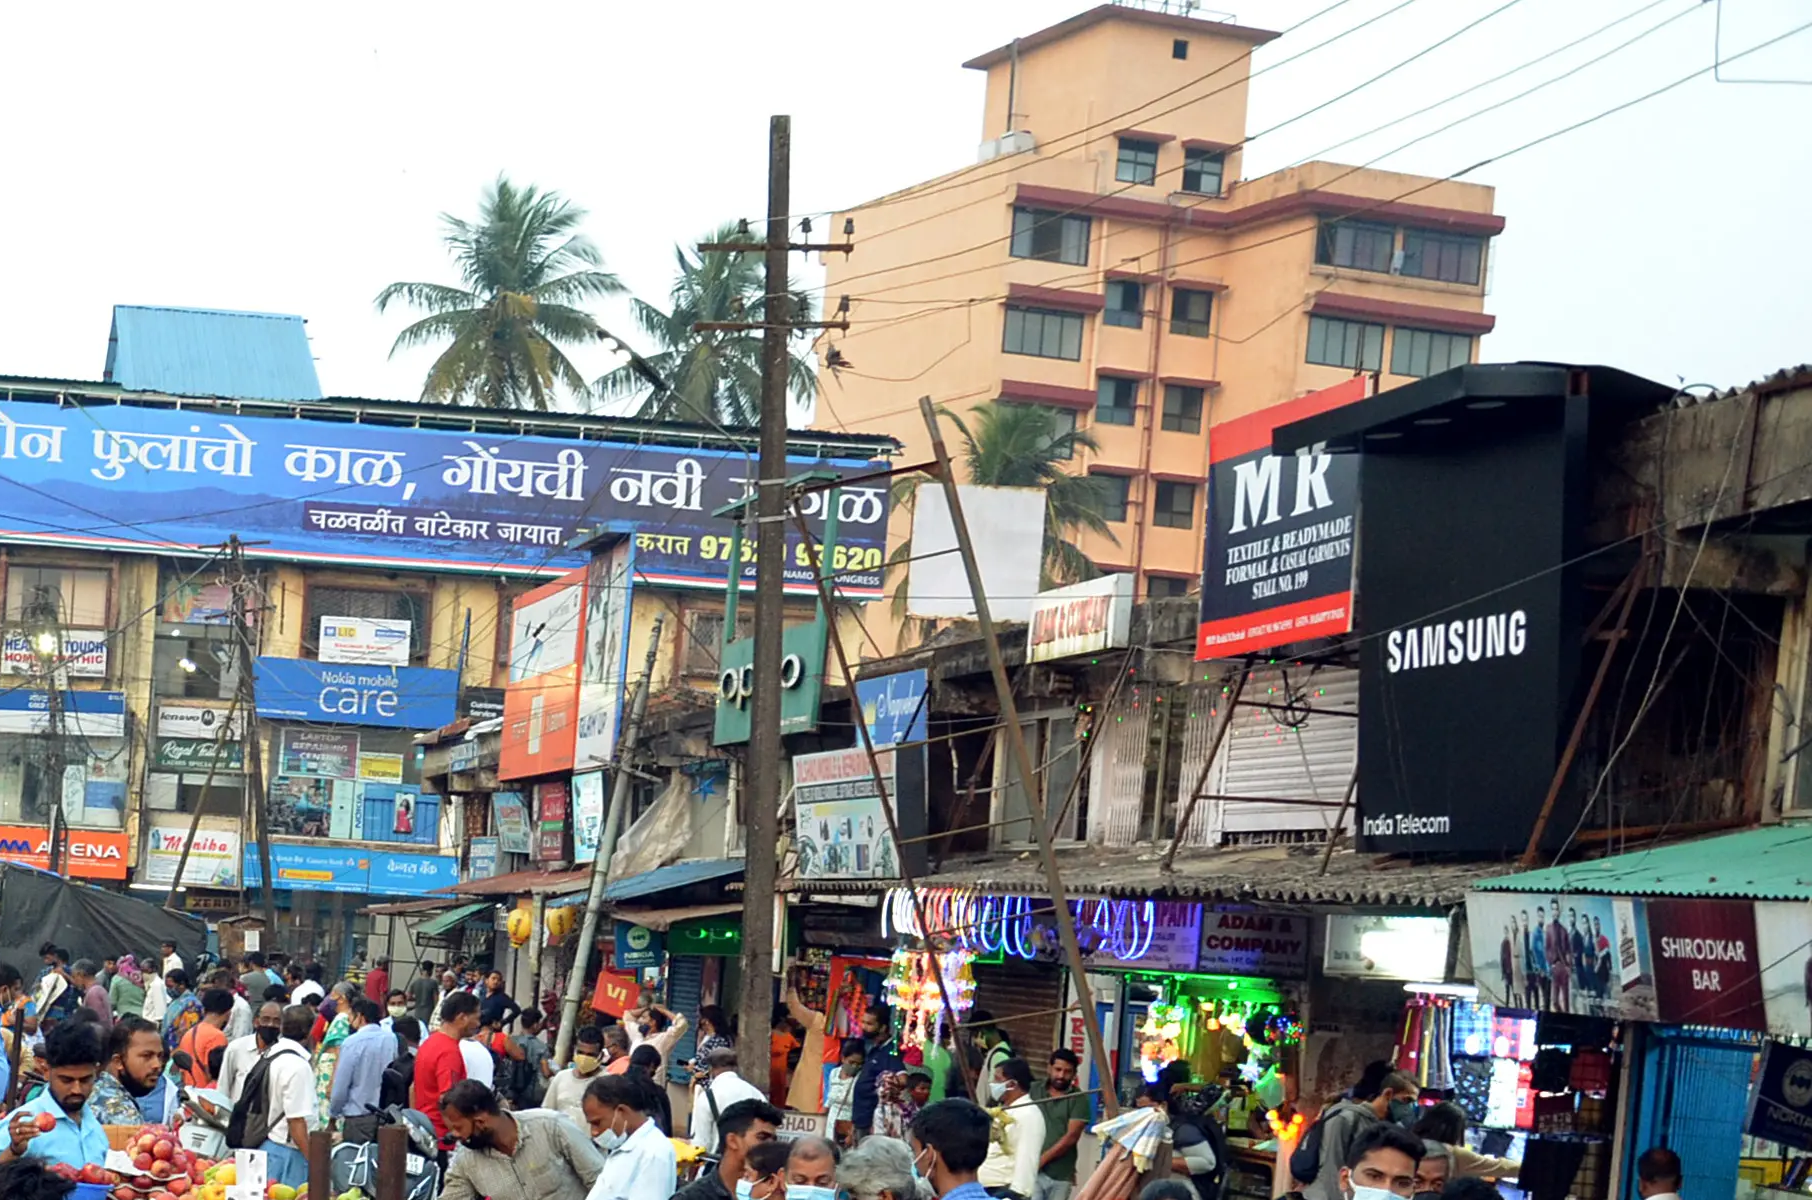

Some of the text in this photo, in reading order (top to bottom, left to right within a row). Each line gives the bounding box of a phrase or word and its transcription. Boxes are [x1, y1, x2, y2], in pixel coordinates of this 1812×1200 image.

[610, 458, 707, 511] नवी
[636, 531, 692, 557] करात
[1227, 515, 1353, 565] TEXTILE & READYMADE
[1225, 537, 1351, 586] FORMAL & CASUAL GARMENTS
[826, 573, 880, 586] ONGRESS
[1251, 578, 1276, 600] STALL
[64, 640, 103, 654] TOUCH
[1387, 609, 1527, 674] SAMSUNG
[321, 671, 399, 689] Nokia mobile
[721, 653, 801, 711] opo
[319, 686, 399, 717] care
[161, 711, 200, 721] lenovo
[355, 792, 363, 829] NOKIA
[1362, 813, 1450, 837] India Telecom
[1218, 914, 1274, 932] ADAM
[1206, 934, 1302, 955] COMPANY
[1661, 936, 1747, 963] SHIRODKAR
[1692, 969, 1721, 992] BAR
